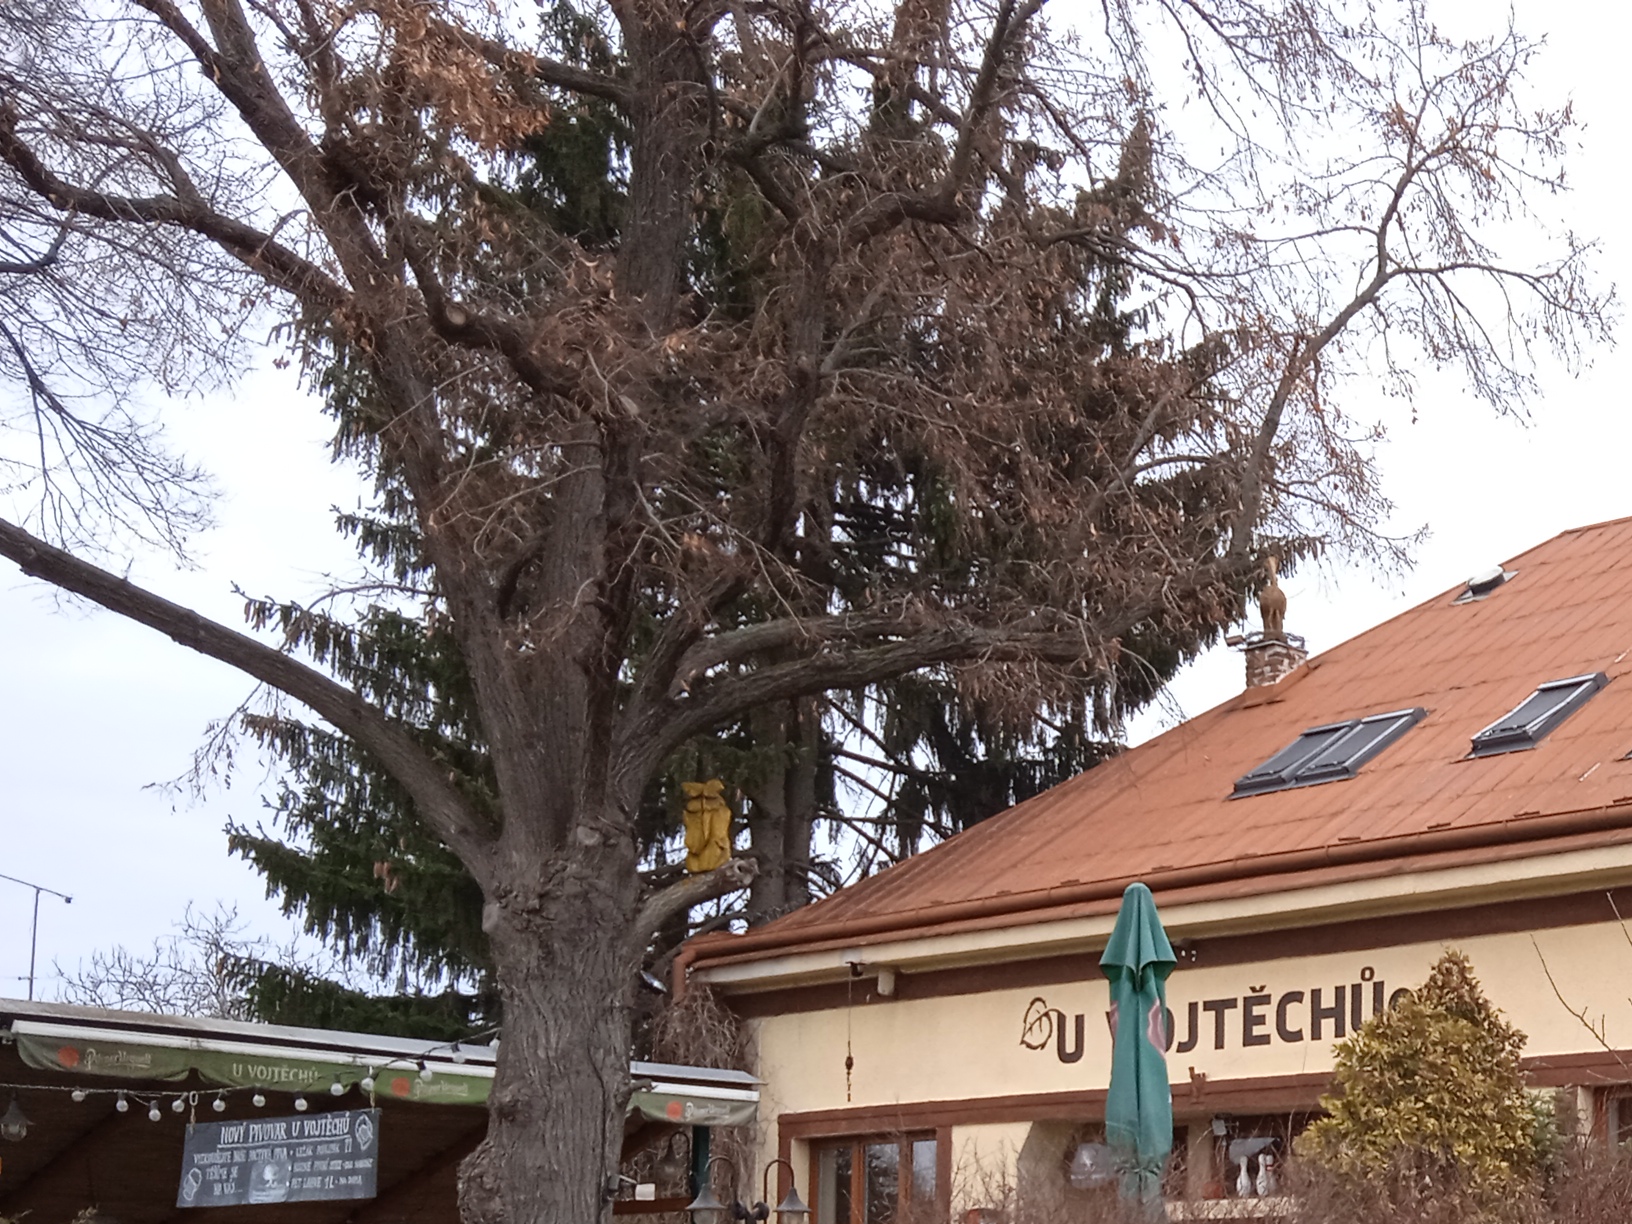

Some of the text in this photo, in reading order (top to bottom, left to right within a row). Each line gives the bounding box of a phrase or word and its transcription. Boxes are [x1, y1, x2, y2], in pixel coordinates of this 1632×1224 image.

[1057, 1013, 1085, 1064] U
[232, 1062, 243, 1078] U
[220, 1122, 246, 1144] NOVÝ
[248, 1122, 287, 1143] PIVOVAR
[292, 1120, 301, 1137] U
